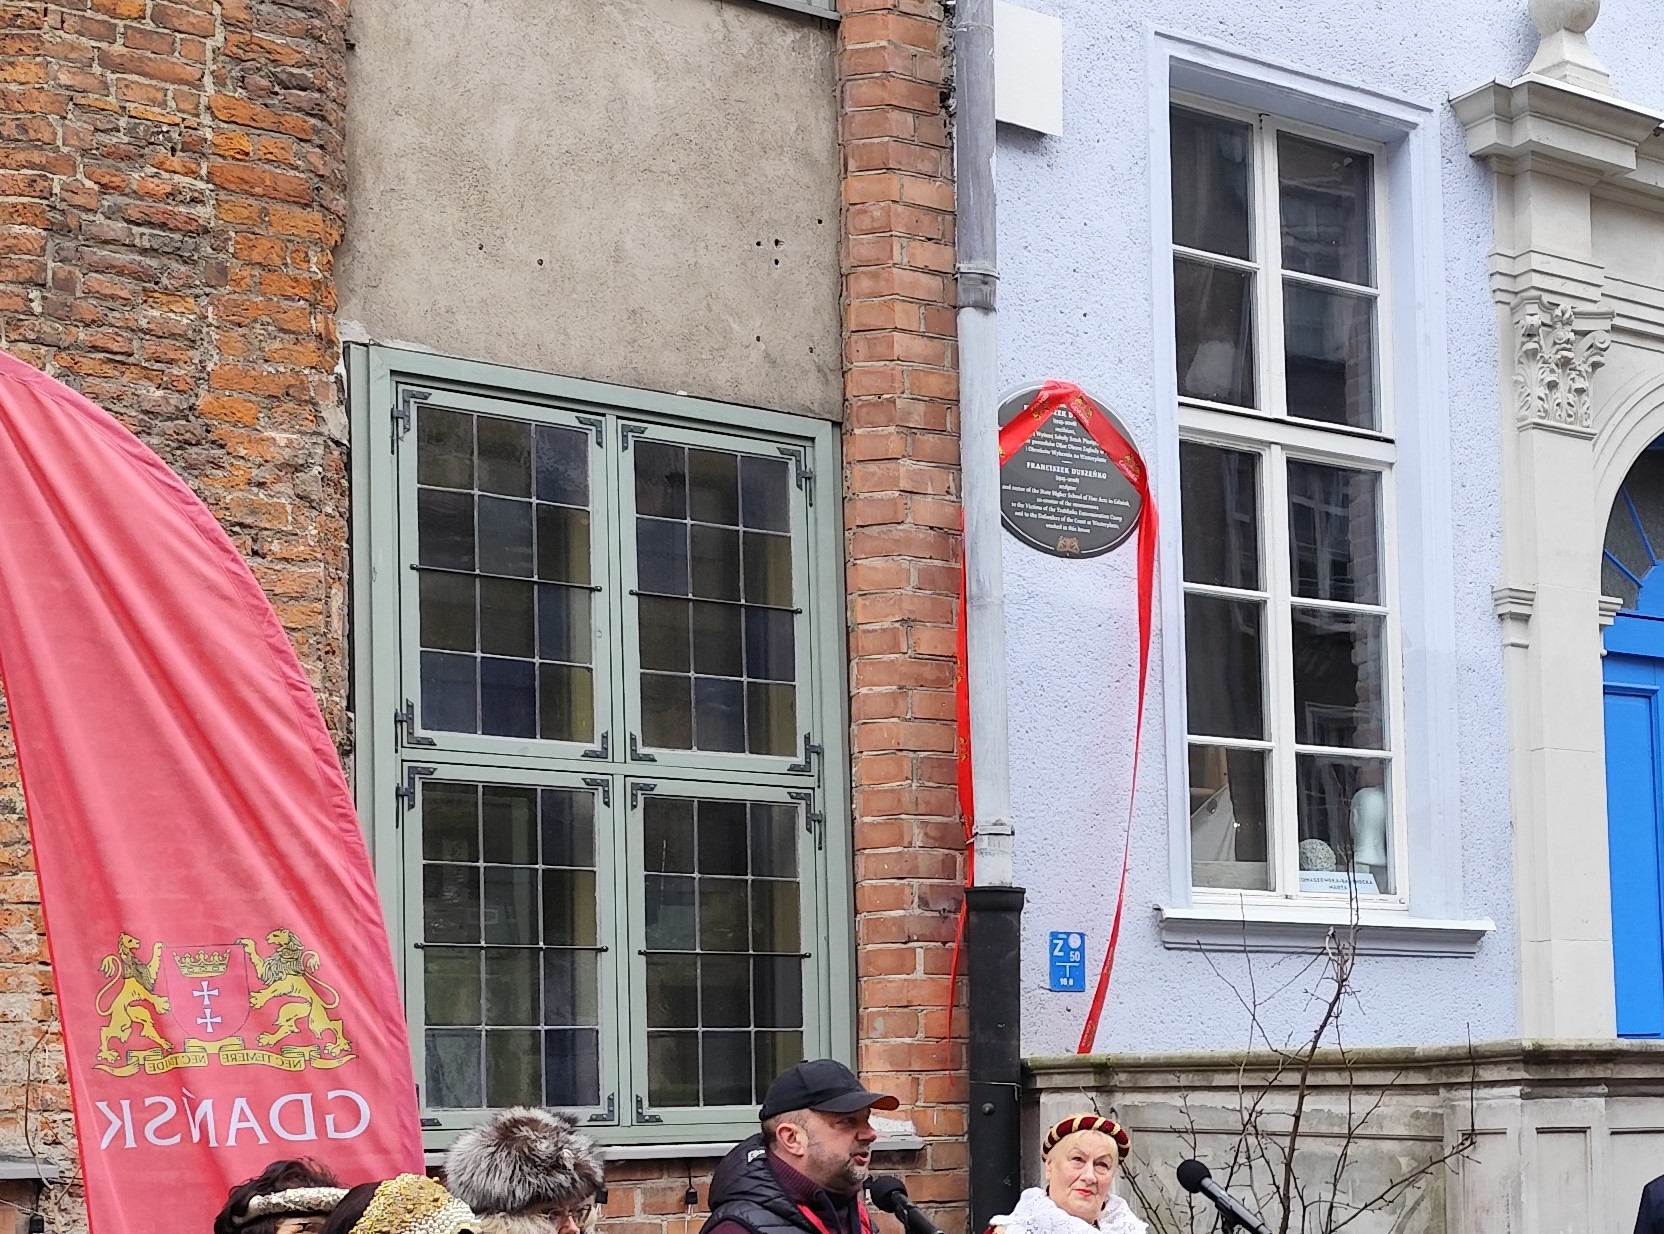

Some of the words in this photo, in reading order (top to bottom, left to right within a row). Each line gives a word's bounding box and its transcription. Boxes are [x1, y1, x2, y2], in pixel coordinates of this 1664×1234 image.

[1026, 461, 1069, 474] FRANCISZEK
[1052, 939, 1065, 957] Z
[1070, 951, 1081, 962] 50
